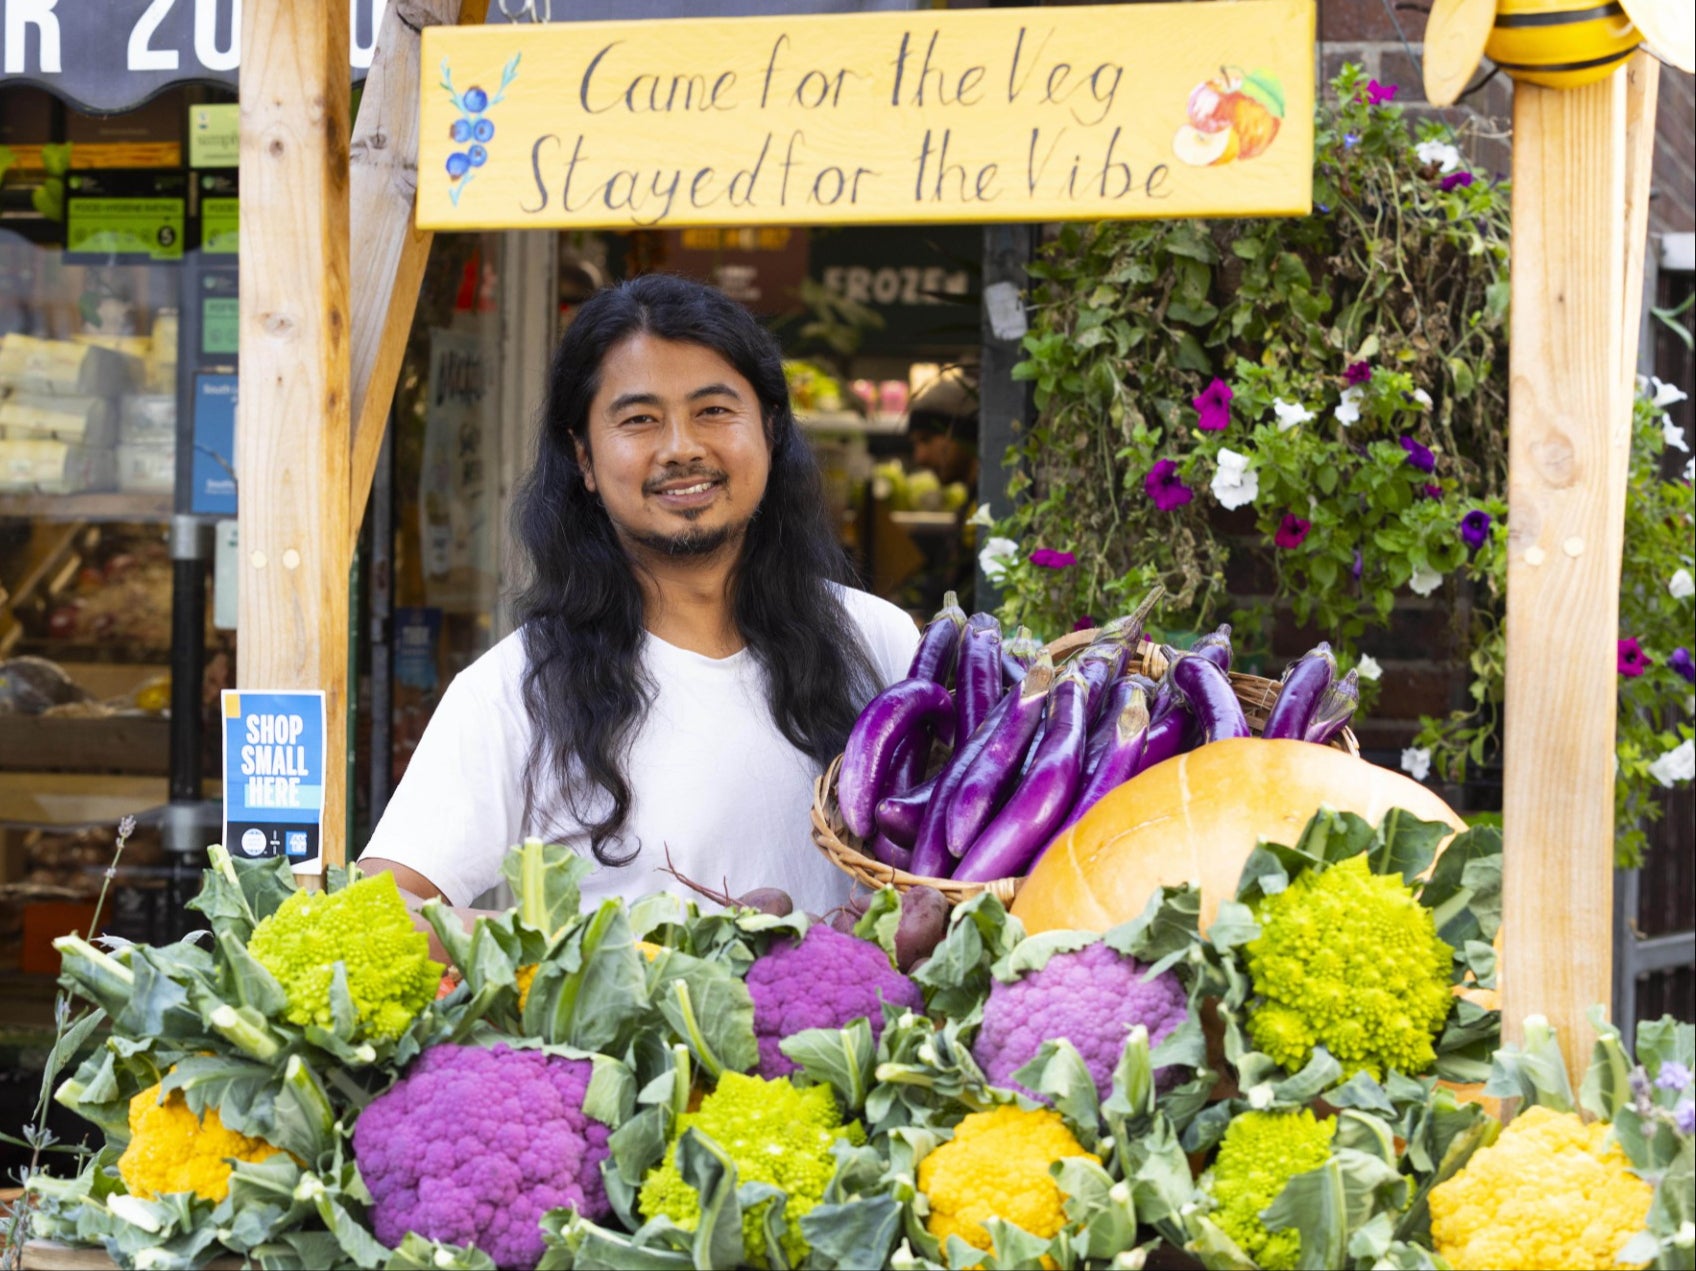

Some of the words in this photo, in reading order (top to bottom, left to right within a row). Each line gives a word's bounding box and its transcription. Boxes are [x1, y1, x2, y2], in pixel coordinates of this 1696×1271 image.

[579, 39, 738, 115] Came
[760, 33, 864, 110] for
[890, 29, 987, 107] the
[1007, 26, 1124, 127] Veg
[518, 132, 772, 226] Stayed
[780, 129, 882, 206] for
[913, 128, 1000, 202] the
[1028, 126, 1174, 200] Vibe
[245, 713, 304, 745] SHOP
[240, 745, 309, 776] SMALL
[248, 776, 301, 807] HERE
